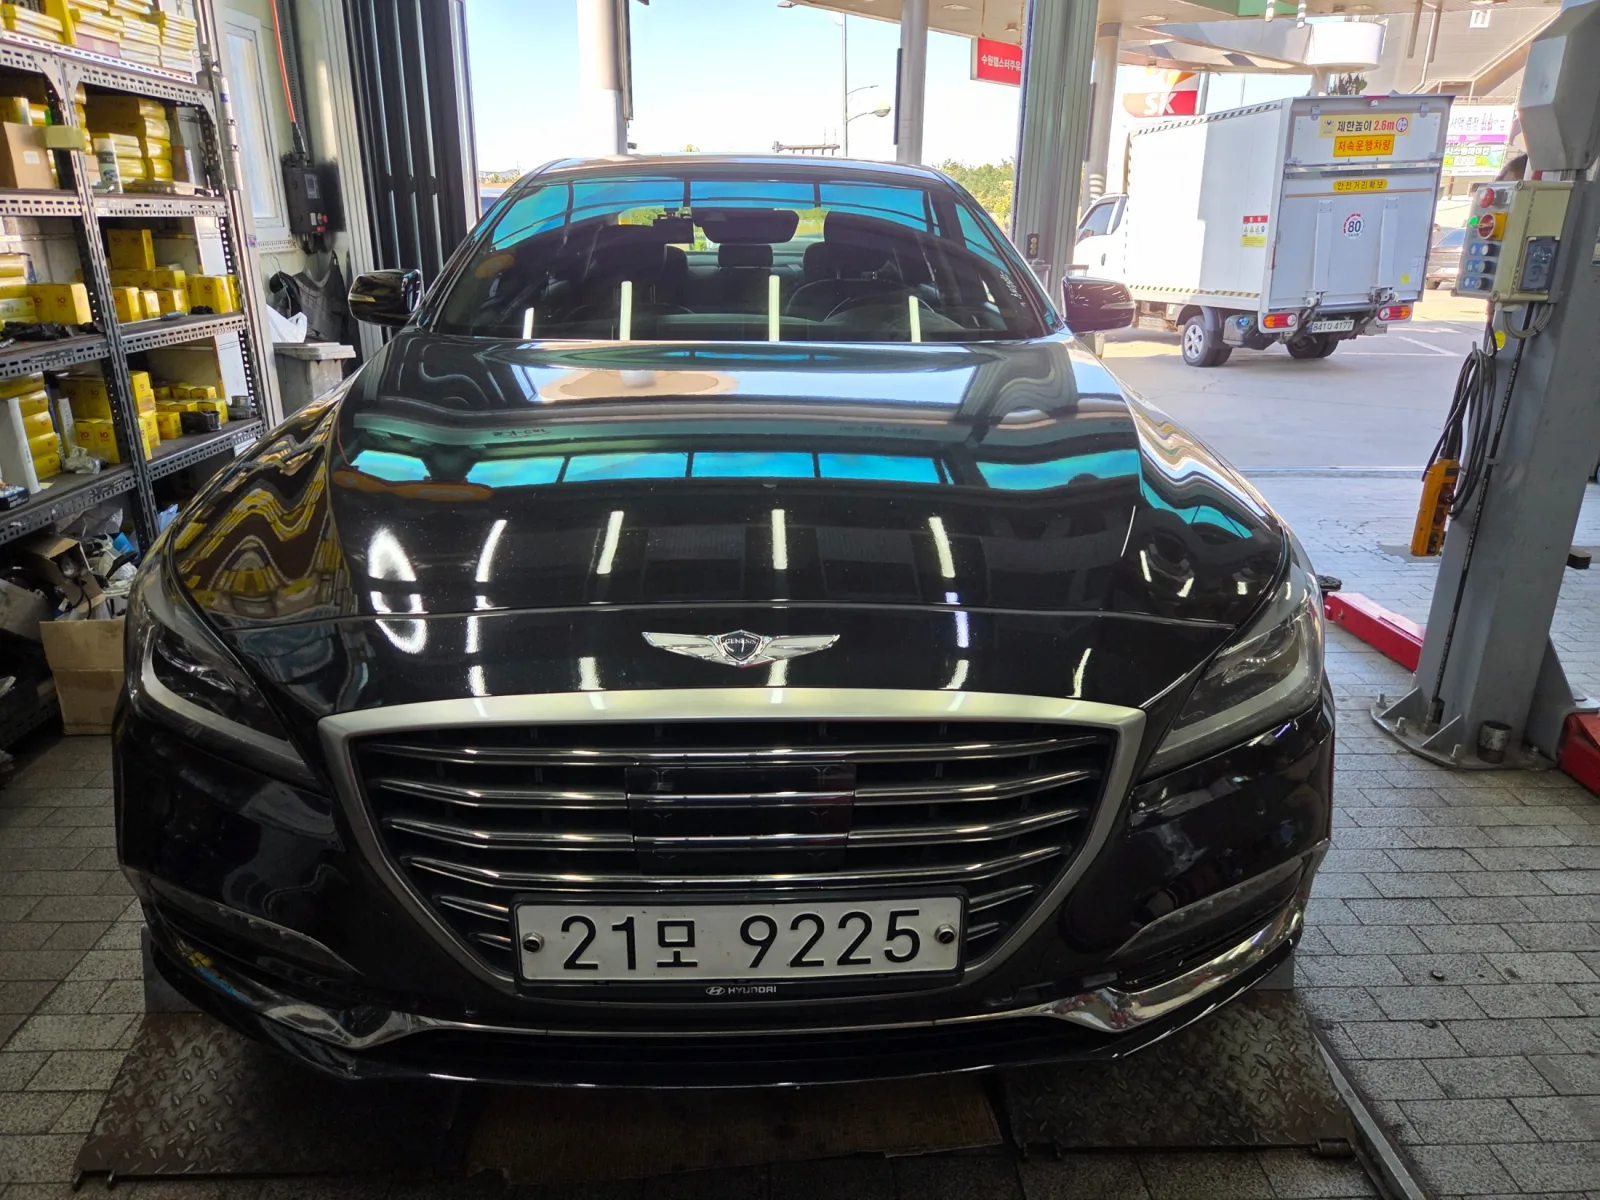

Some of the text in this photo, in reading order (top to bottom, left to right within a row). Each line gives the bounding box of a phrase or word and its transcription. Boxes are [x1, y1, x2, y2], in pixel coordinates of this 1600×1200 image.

[1144, 92, 1177, 116] SK
[1336, 120, 1372, 133] 제한높이
[1373, 119, 1395, 131] 2.6m
[1338, 139, 1392, 152] 저속운행차량
[1337, 181, 1384, 191] 안전거리확보
[1347, 220, 1362, 233] 80
[560, 909, 921, 971] 21모 9225
[727, 985, 777, 995] HYUNDAI
